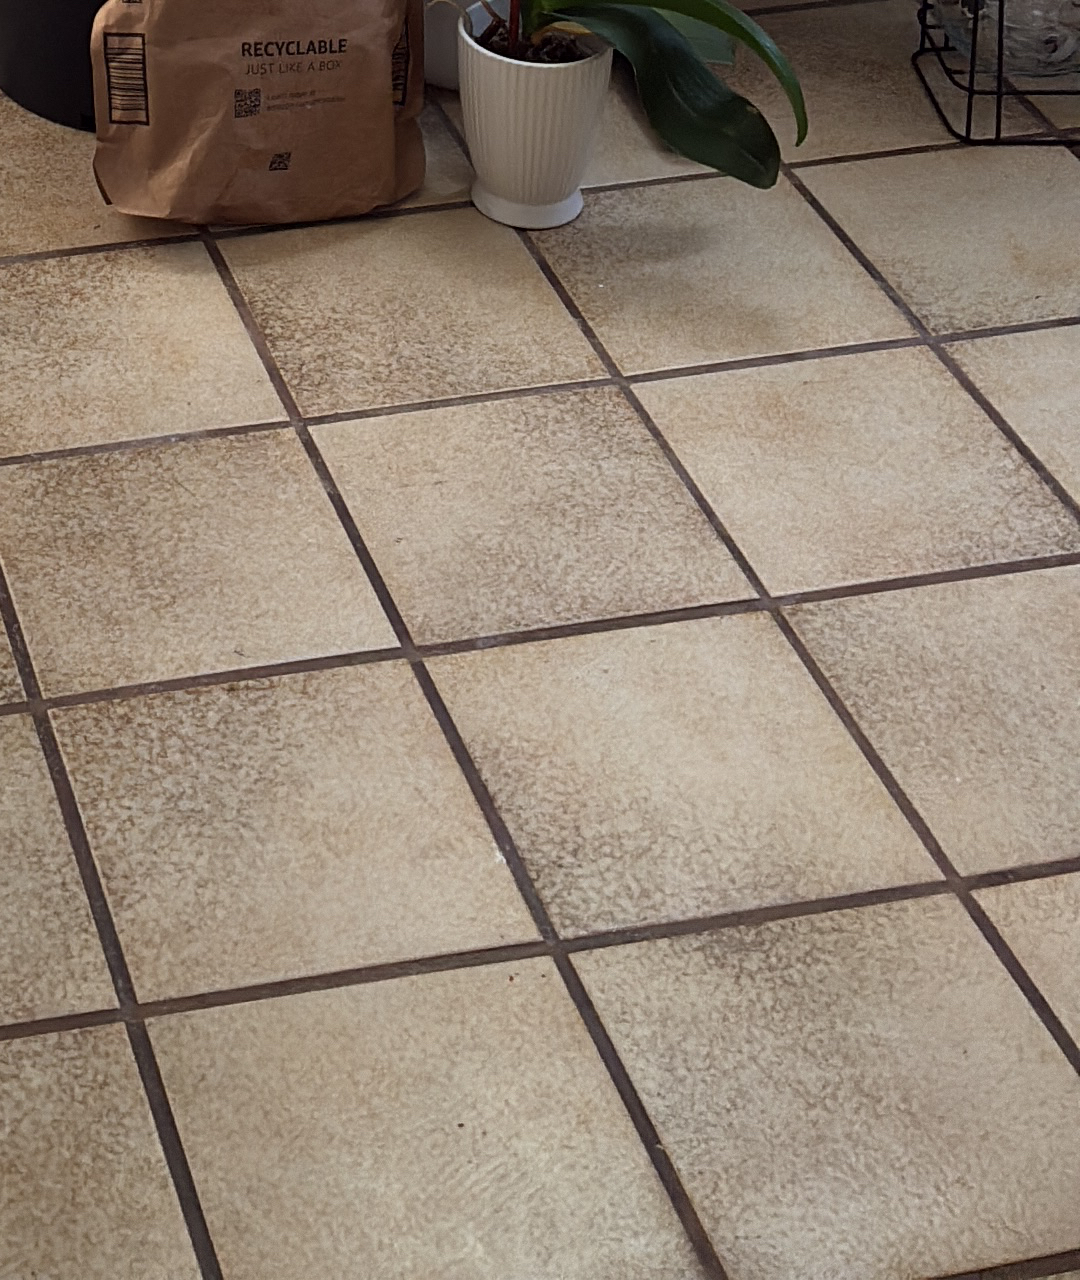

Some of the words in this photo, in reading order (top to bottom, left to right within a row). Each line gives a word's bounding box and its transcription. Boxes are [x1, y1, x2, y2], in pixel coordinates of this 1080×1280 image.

[241, 38, 348, 57] RECYCLABLE
[245, 62, 275, 76] JUST
[279, 61, 303, 74] LIKE
[306, 62, 315, 72] A
[319, 60, 343, 72] BOX
